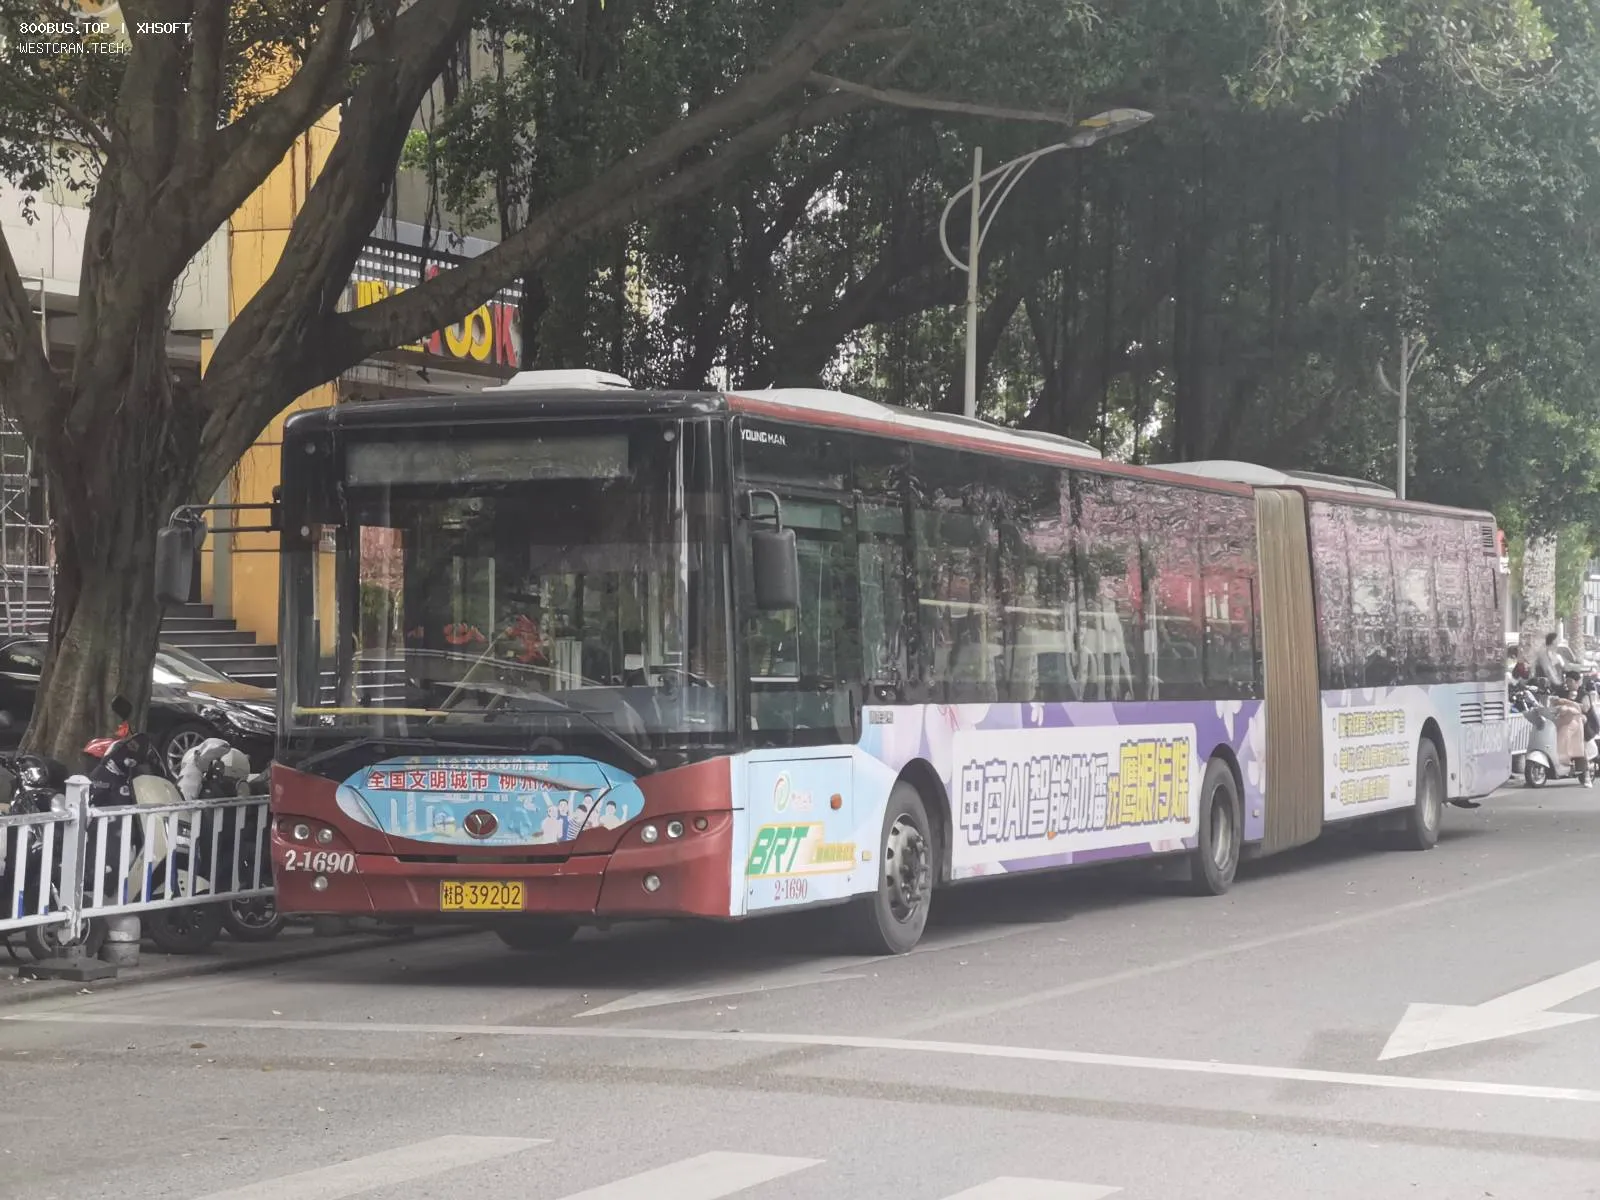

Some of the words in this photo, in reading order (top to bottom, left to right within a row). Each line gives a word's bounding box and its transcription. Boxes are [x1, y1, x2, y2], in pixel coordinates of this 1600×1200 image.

[368, 769, 490, 791] 全国文明城市
[284, 849, 355, 874] 2-1690
[745, 826, 810, 876] BRT
